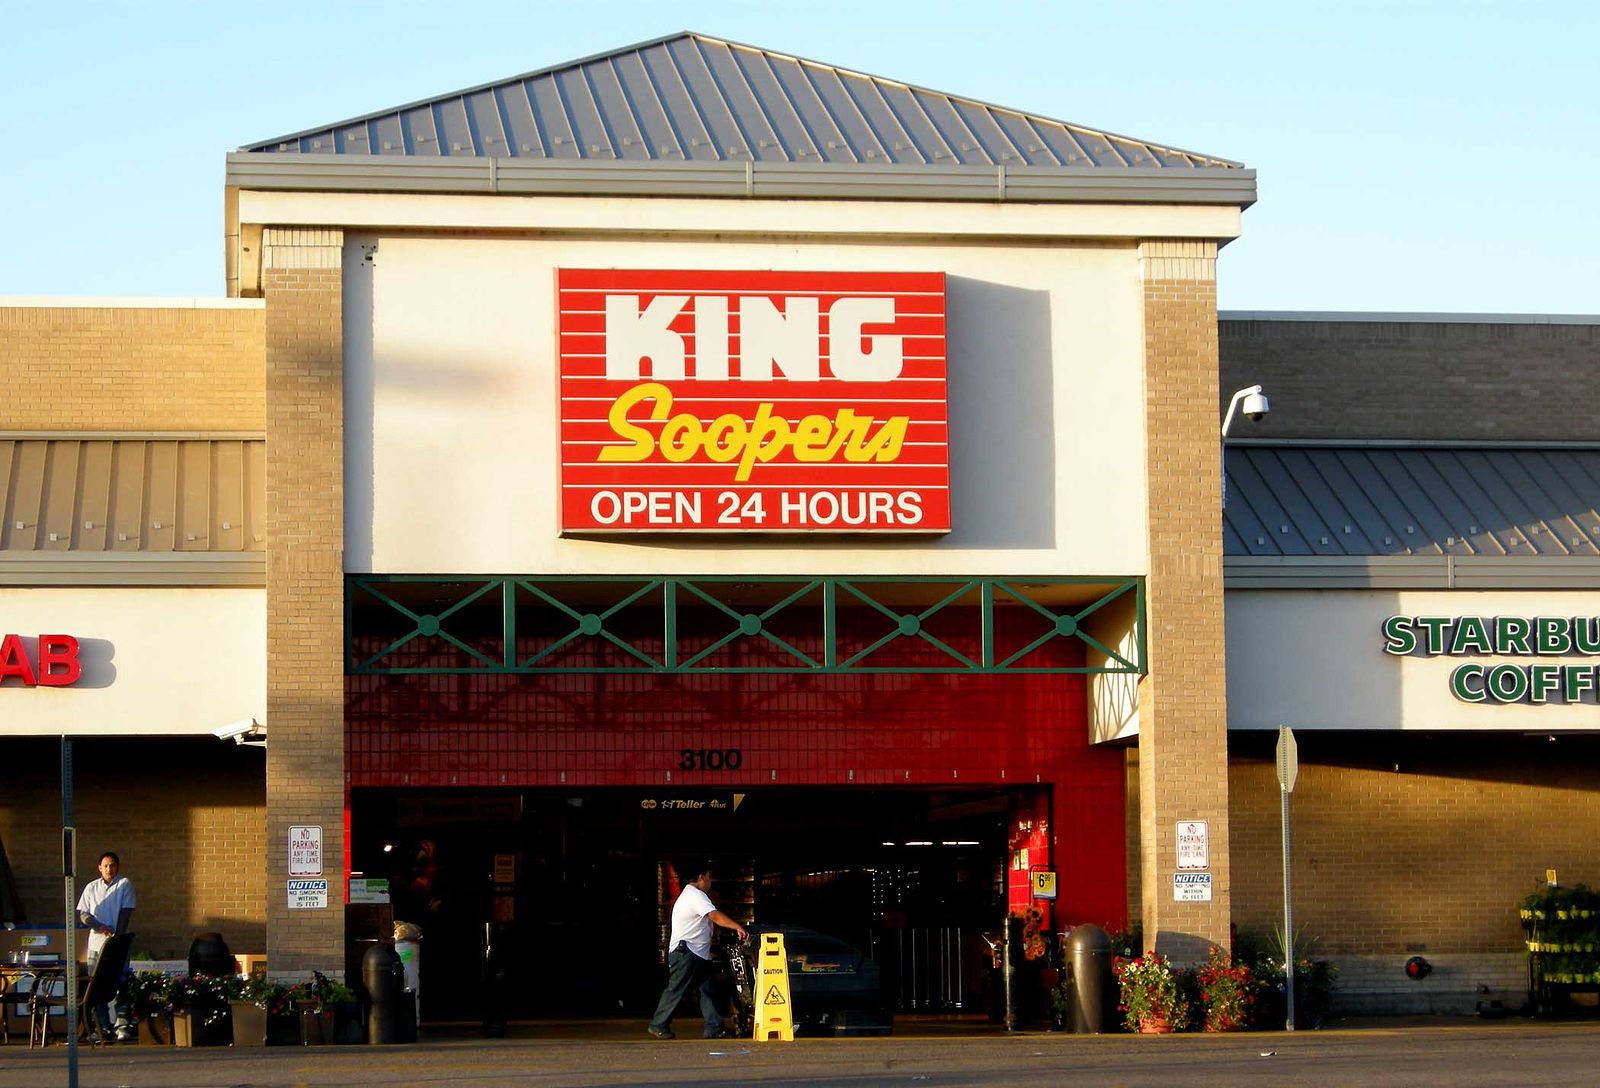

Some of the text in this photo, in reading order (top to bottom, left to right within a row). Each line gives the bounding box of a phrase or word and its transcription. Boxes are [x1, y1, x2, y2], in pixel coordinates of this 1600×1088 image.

[605, 294, 903, 382] KING
[596, 382, 910, 482] Soopers
[590, 490, 923, 525] OPEN 24 HOURS
[1452, 662, 1600, 702] COFF
[678, 748, 743, 771] 3100
[301, 830, 310, 839] NO
[1187, 826, 1196, 834] NO
[1179, 834, 1205, 844] PARKING
[292, 840, 319, 850] PARKING
[1175, 874, 1211, 883] NOTICE
[289, 881, 326, 889] NOTICE
